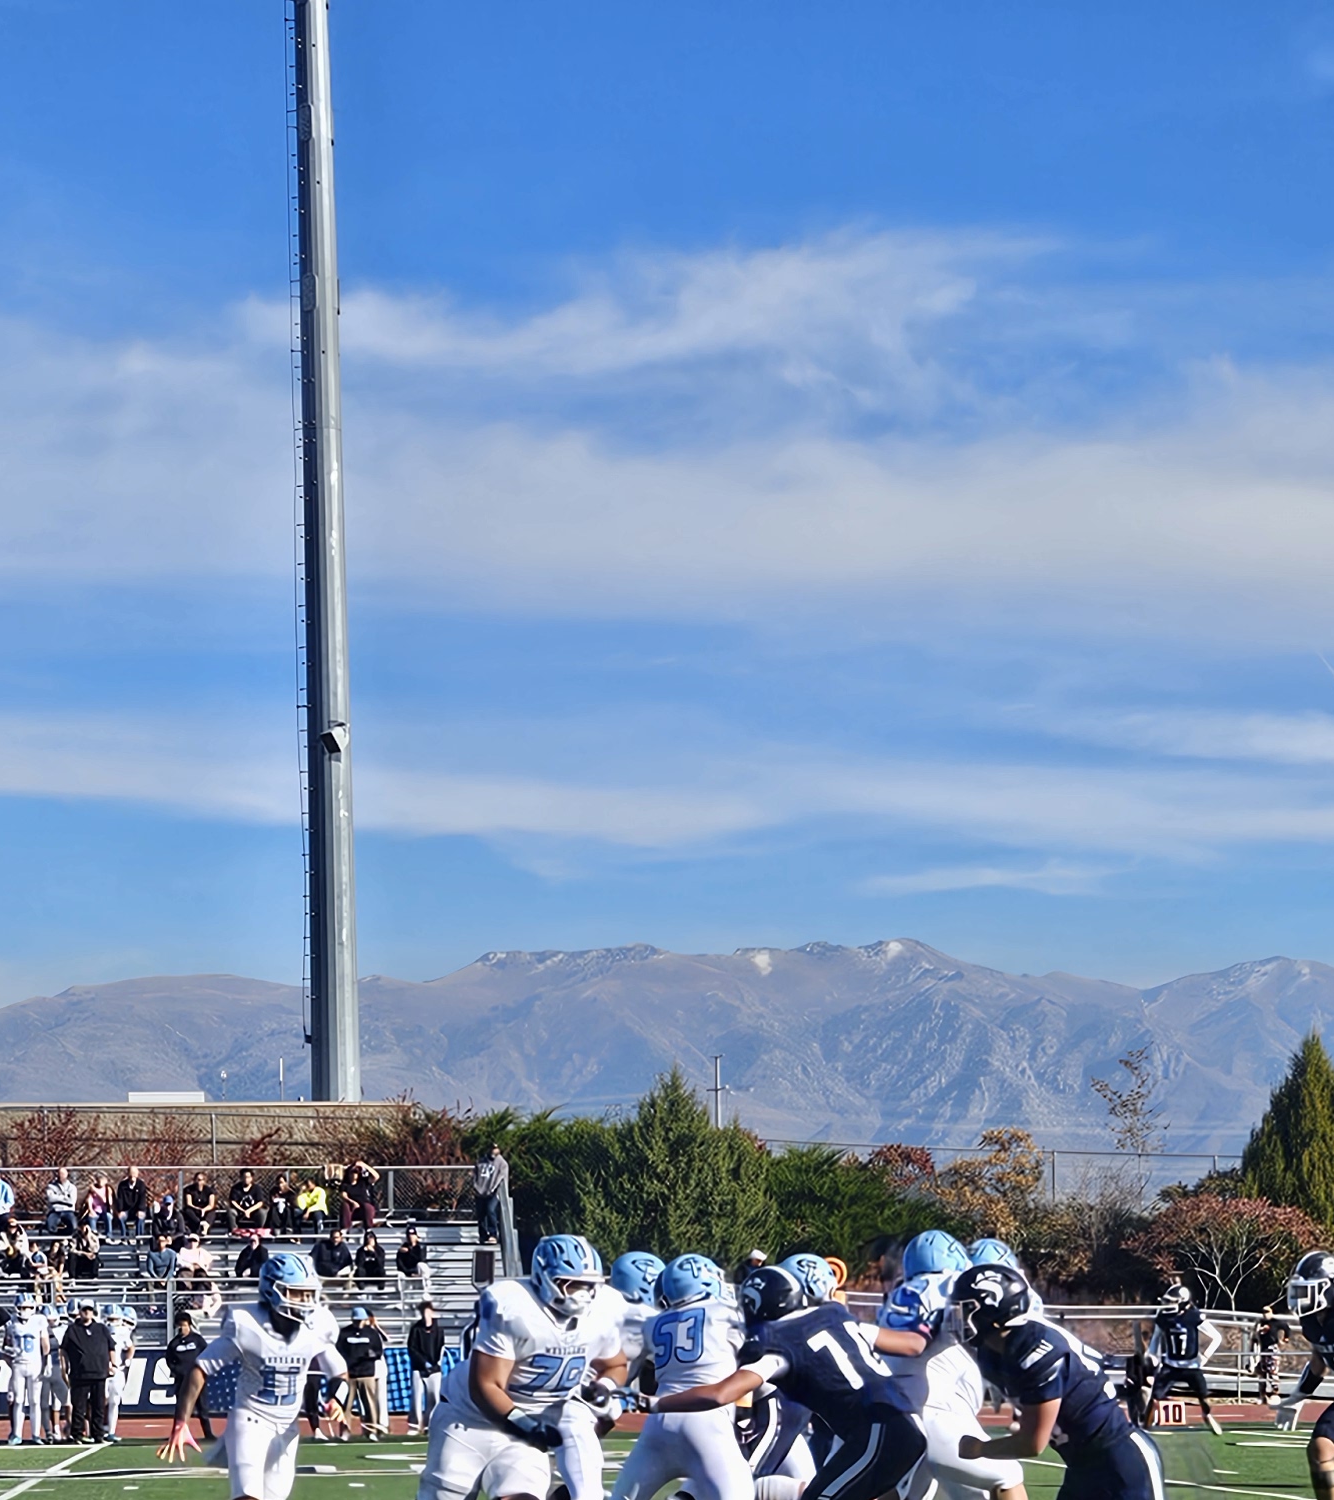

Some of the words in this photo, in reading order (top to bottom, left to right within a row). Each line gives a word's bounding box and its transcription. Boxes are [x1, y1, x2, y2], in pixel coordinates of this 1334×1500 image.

[652, 1307, 706, 1370] 53
[520, 1354, 586, 1393] 70
[1162, 1404, 1183, 1423] 10
